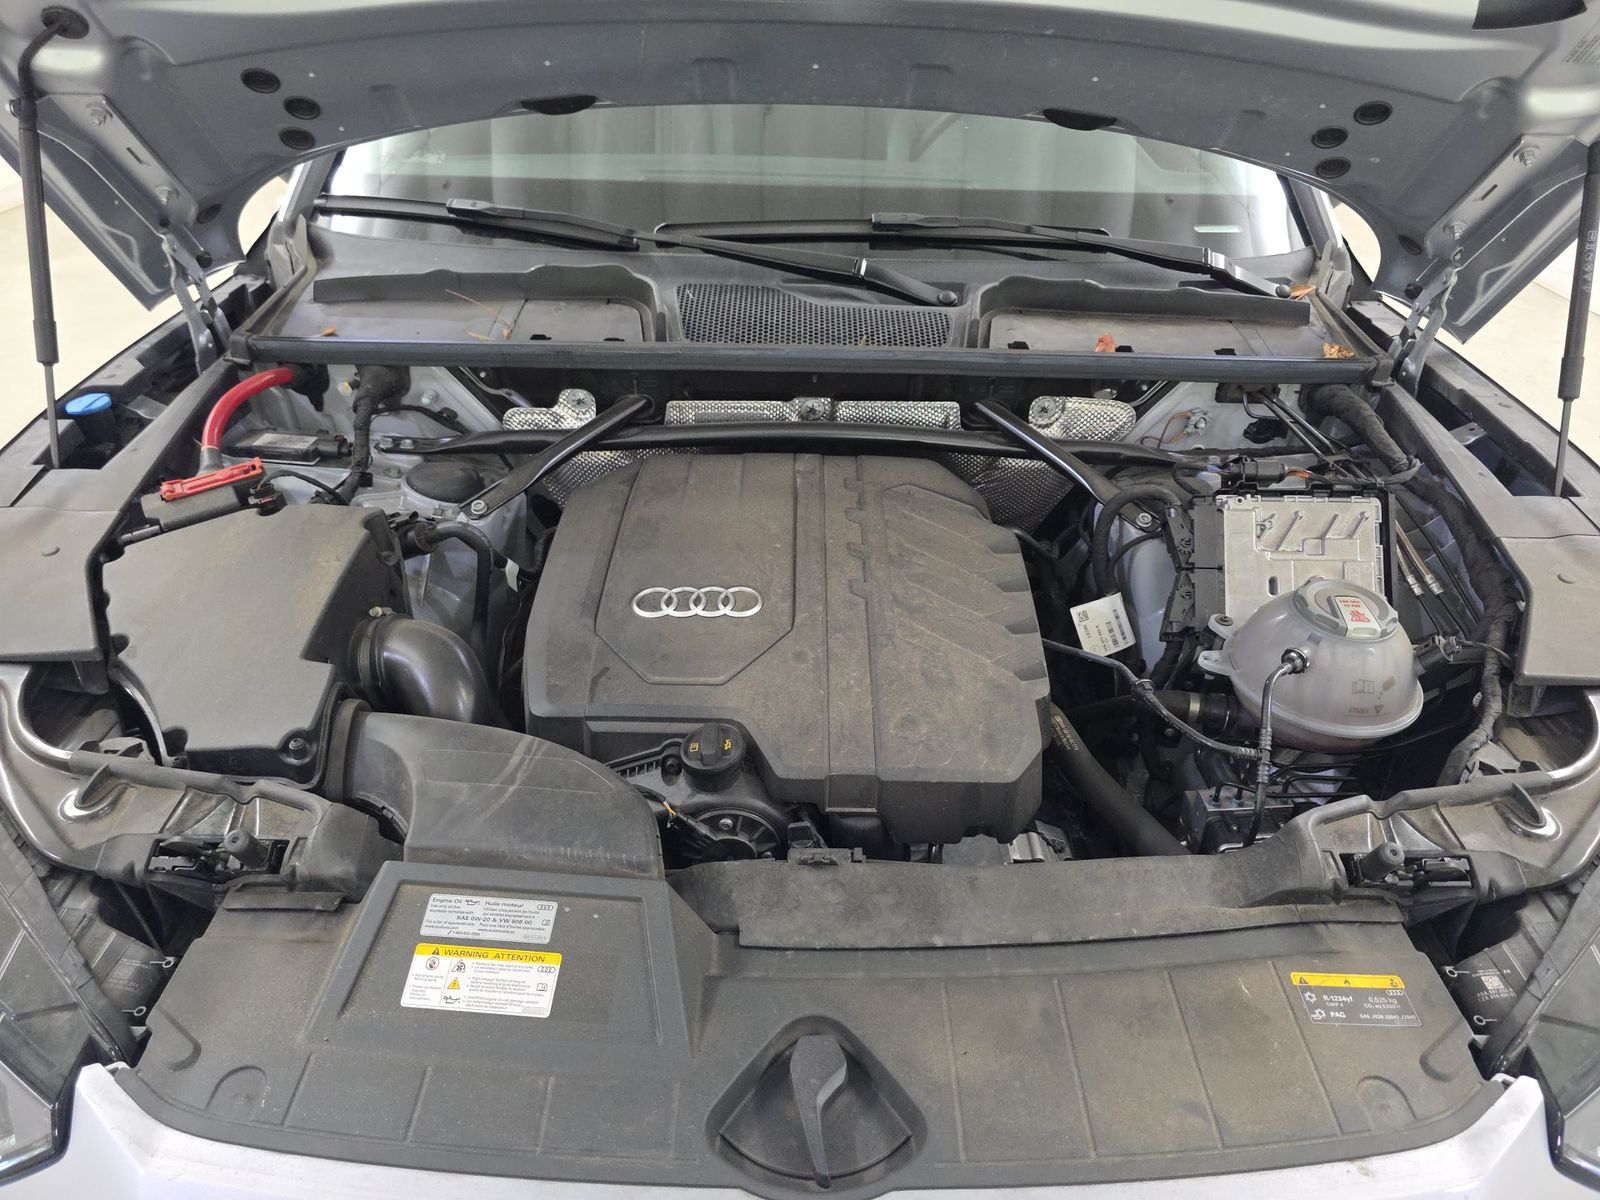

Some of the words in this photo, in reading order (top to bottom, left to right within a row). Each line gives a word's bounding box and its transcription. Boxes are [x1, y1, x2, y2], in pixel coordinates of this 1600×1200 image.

[444, 949, 489, 959] WARNING
[494, 952, 546, 962] ATTENTION
[1323, 994, 1353, 1003] R-1234yf
[1388, 997, 1398, 1005] kg
